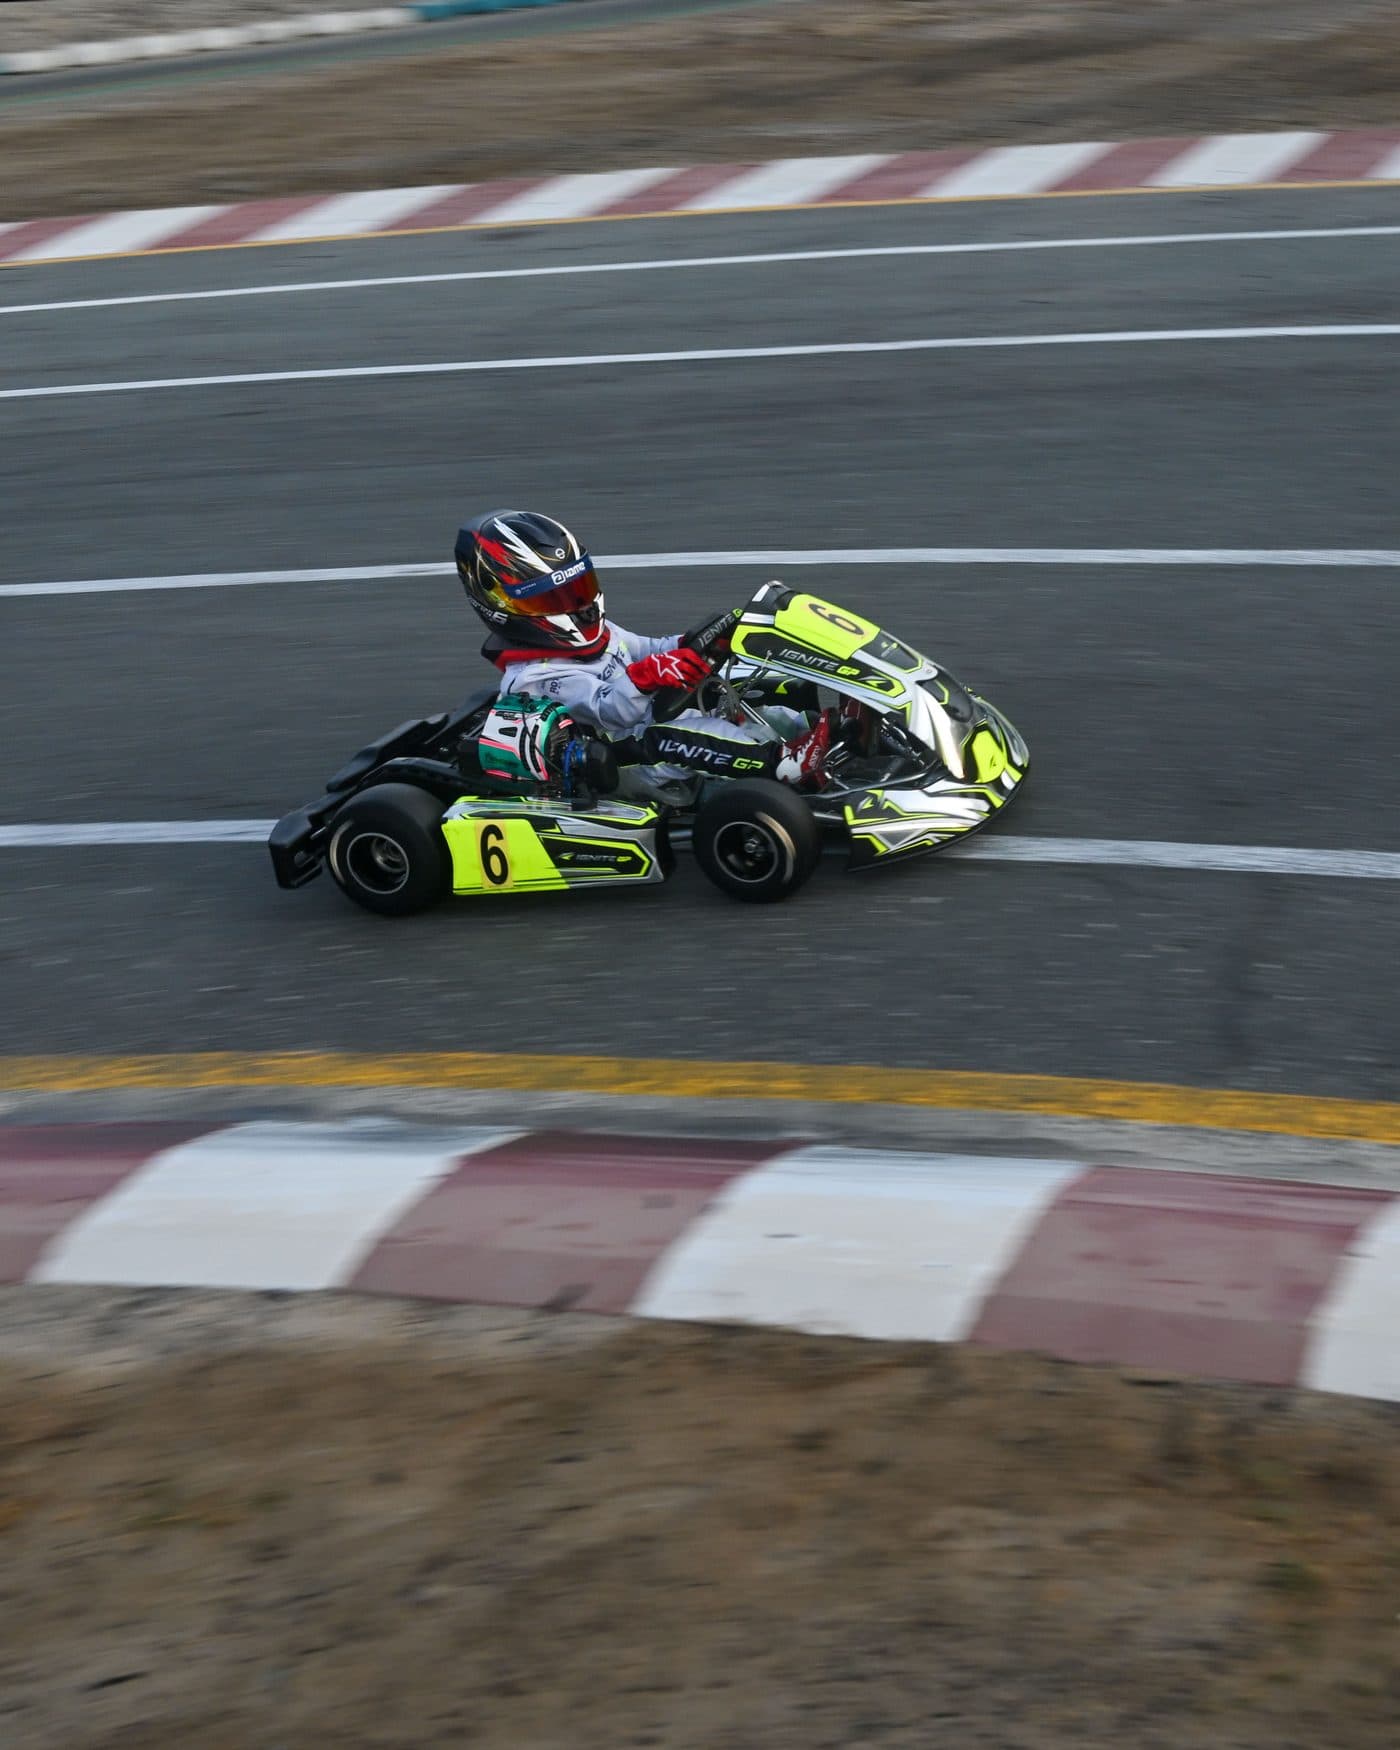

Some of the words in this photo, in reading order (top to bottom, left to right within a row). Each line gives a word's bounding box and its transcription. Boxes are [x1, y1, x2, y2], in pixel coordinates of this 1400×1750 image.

[698, 613, 735, 648] IGNITE
[808, 603, 864, 636] 6
[779, 649, 839, 671] IGNITE
[836, 665, 861, 676] GP
[658, 739, 734, 766] IGNITE
[732, 757, 764, 770] GP
[480, 824, 509, 886] 6
